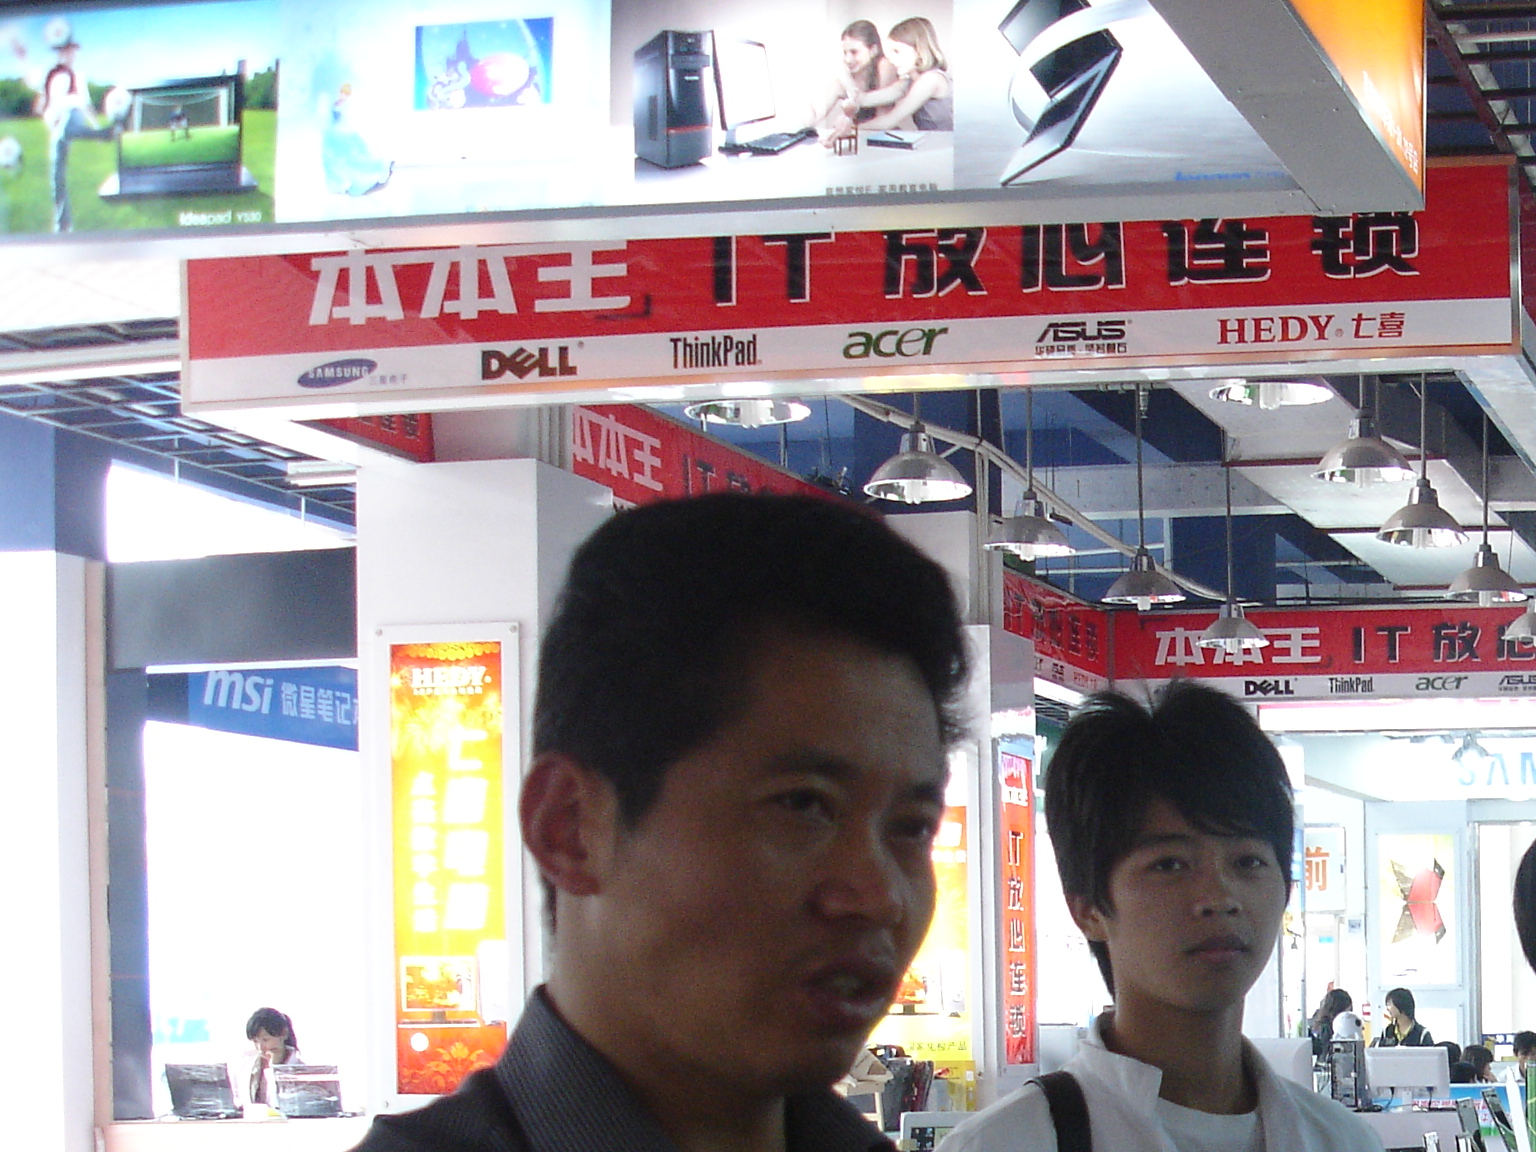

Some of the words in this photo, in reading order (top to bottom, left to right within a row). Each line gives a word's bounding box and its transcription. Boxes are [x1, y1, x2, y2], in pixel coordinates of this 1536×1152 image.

[309, 240, 631, 326] 本本王
[842, 327, 949, 359] acer
[1035, 320, 1127, 343] ASUS
[1217, 314, 1336, 345] HEDY
[1351, 312, 1405, 340] 七喜
[481, 346, 577, 381] DELL
[669, 333, 759, 369] ThinkPad
[307, 364, 372, 380] SAMSUNG
[1154, 626, 1322, 667] 本本王
[203, 670, 275, 715] msi
[411, 666, 486, 688] HEDY
[1244, 679, 1295, 697] DELL
[1328, 677, 1374, 694] ThinkPad
[1415, 674, 1469, 691] acer
